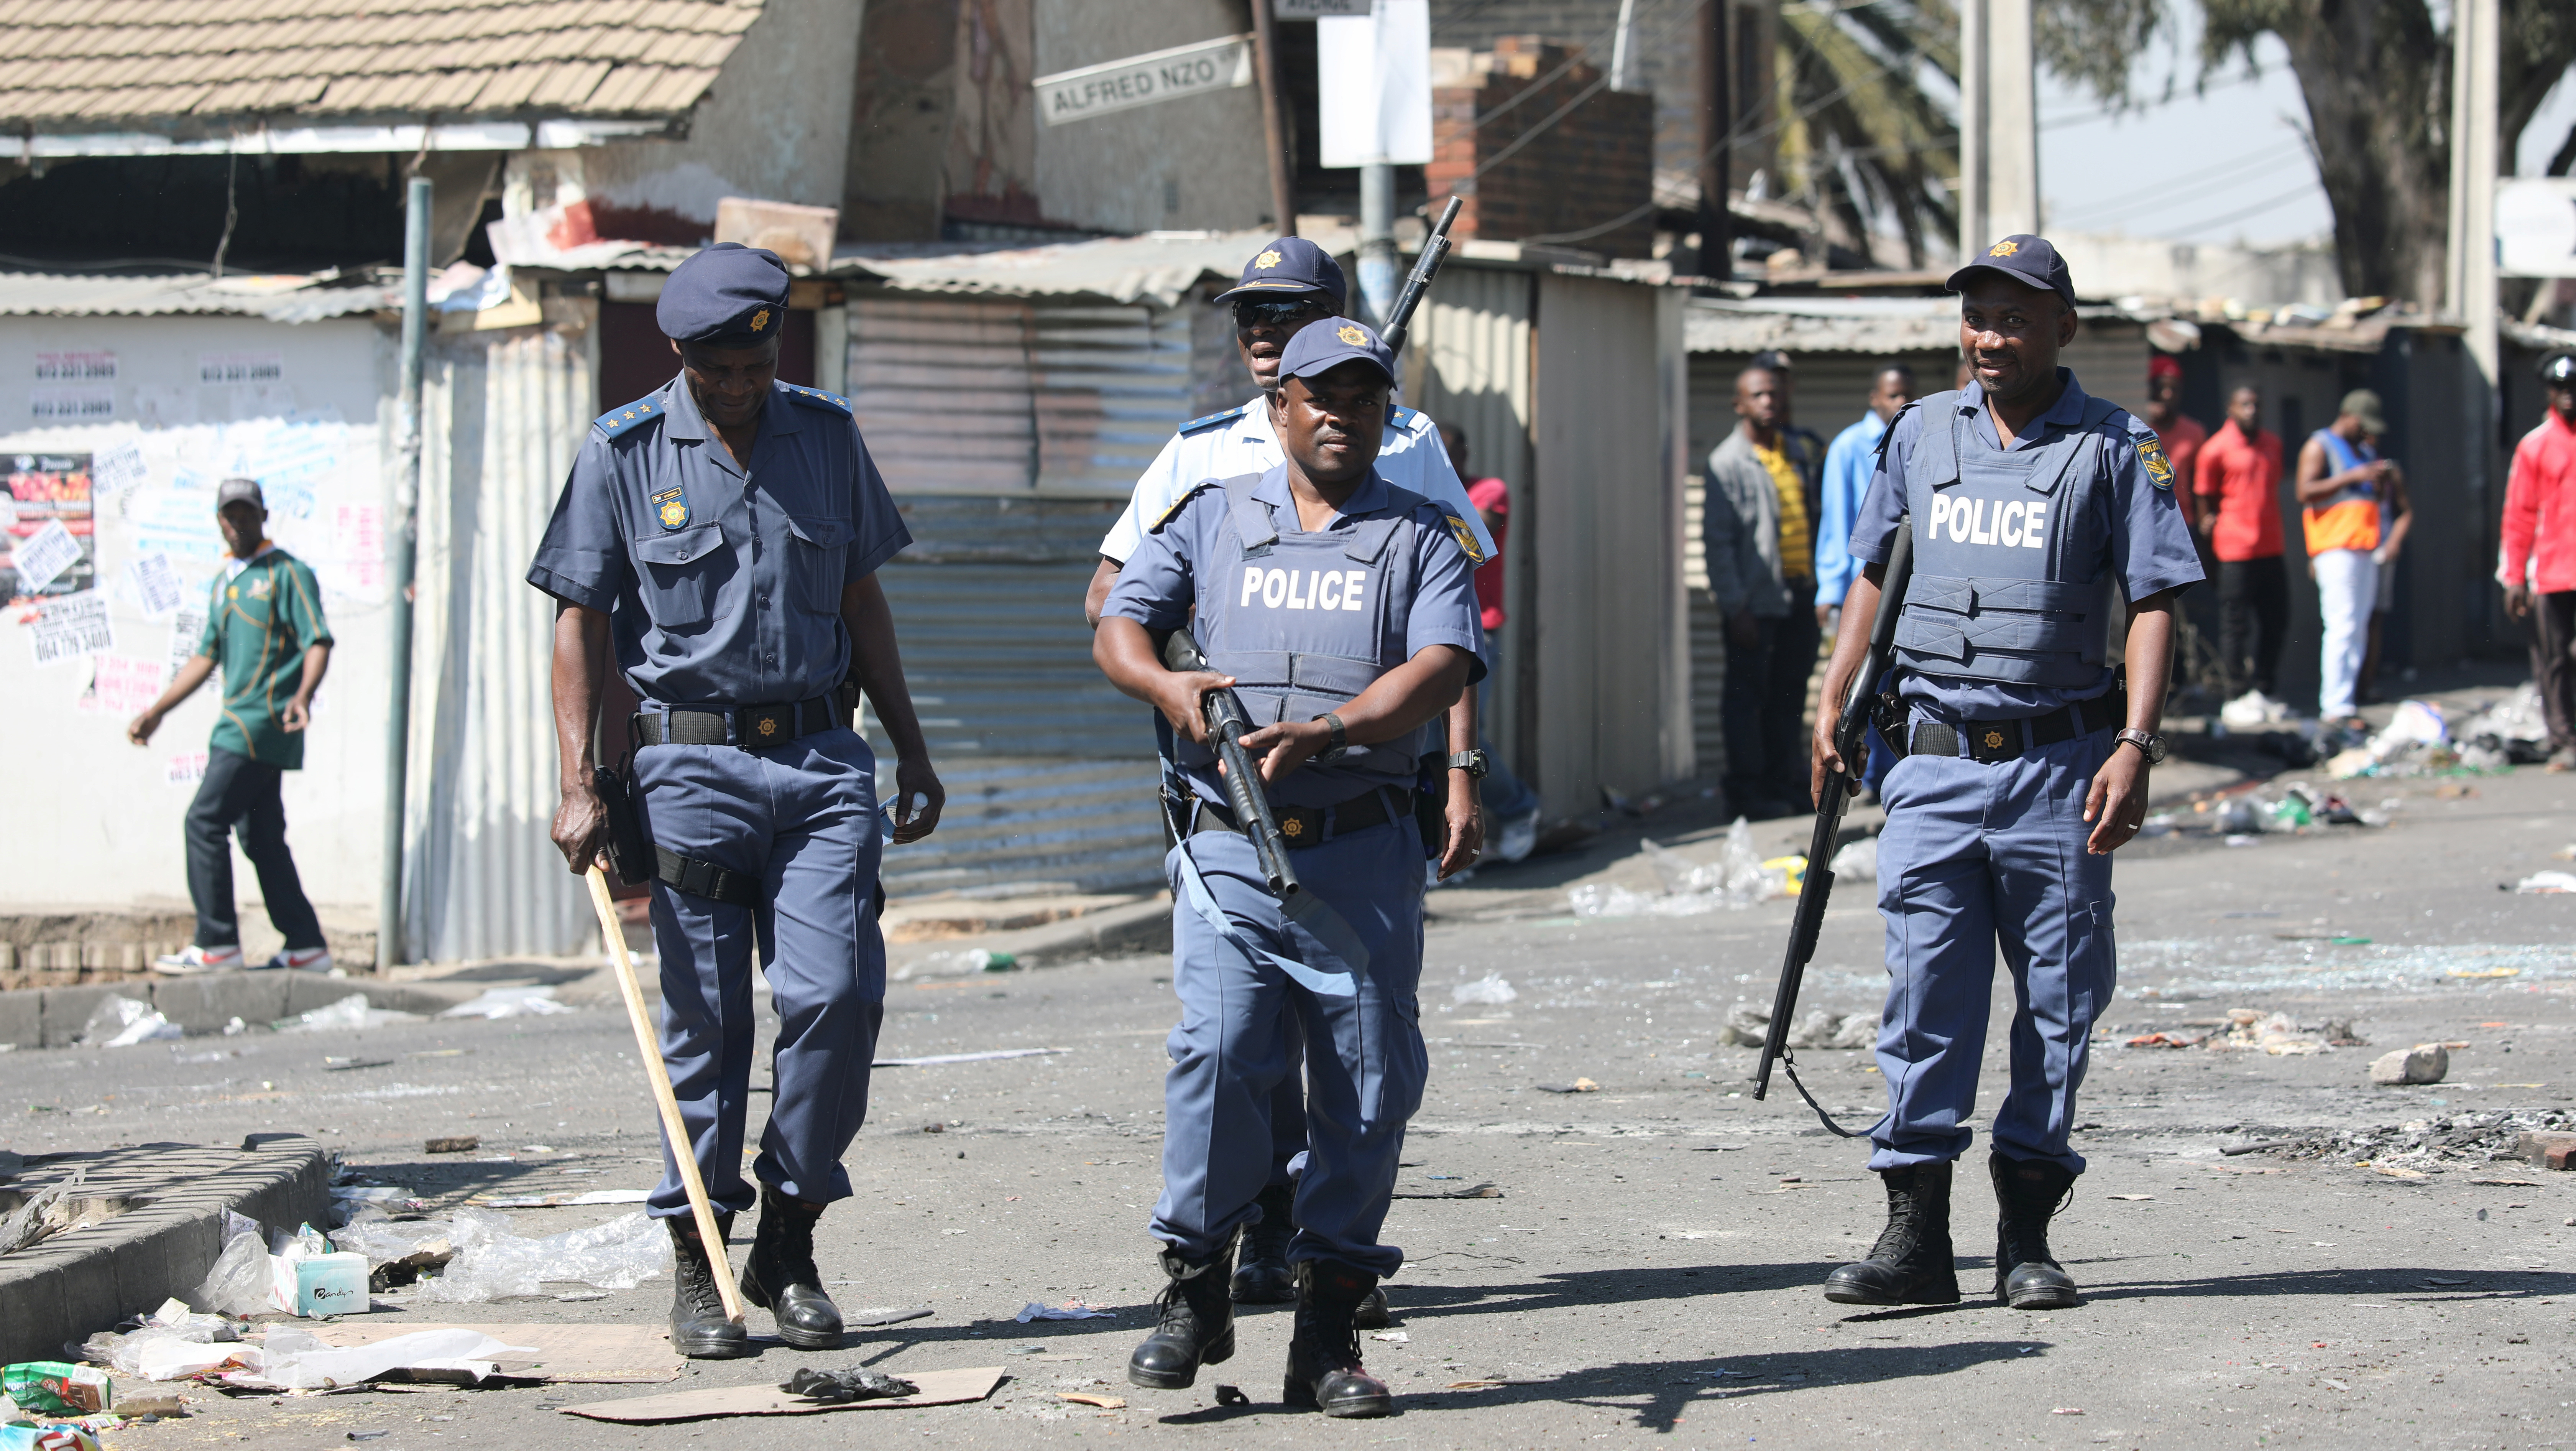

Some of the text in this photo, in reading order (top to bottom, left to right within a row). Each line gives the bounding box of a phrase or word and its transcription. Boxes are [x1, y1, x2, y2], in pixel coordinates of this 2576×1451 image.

[1054, 58, 1215, 113] ALFRED NZO
[2140, 442, 2160, 455] POLICE
[1929, 493, 2047, 548] POLICE
[1240, 567, 1366, 611] POLICE
[314, 1287, 353, 1300] Candy
